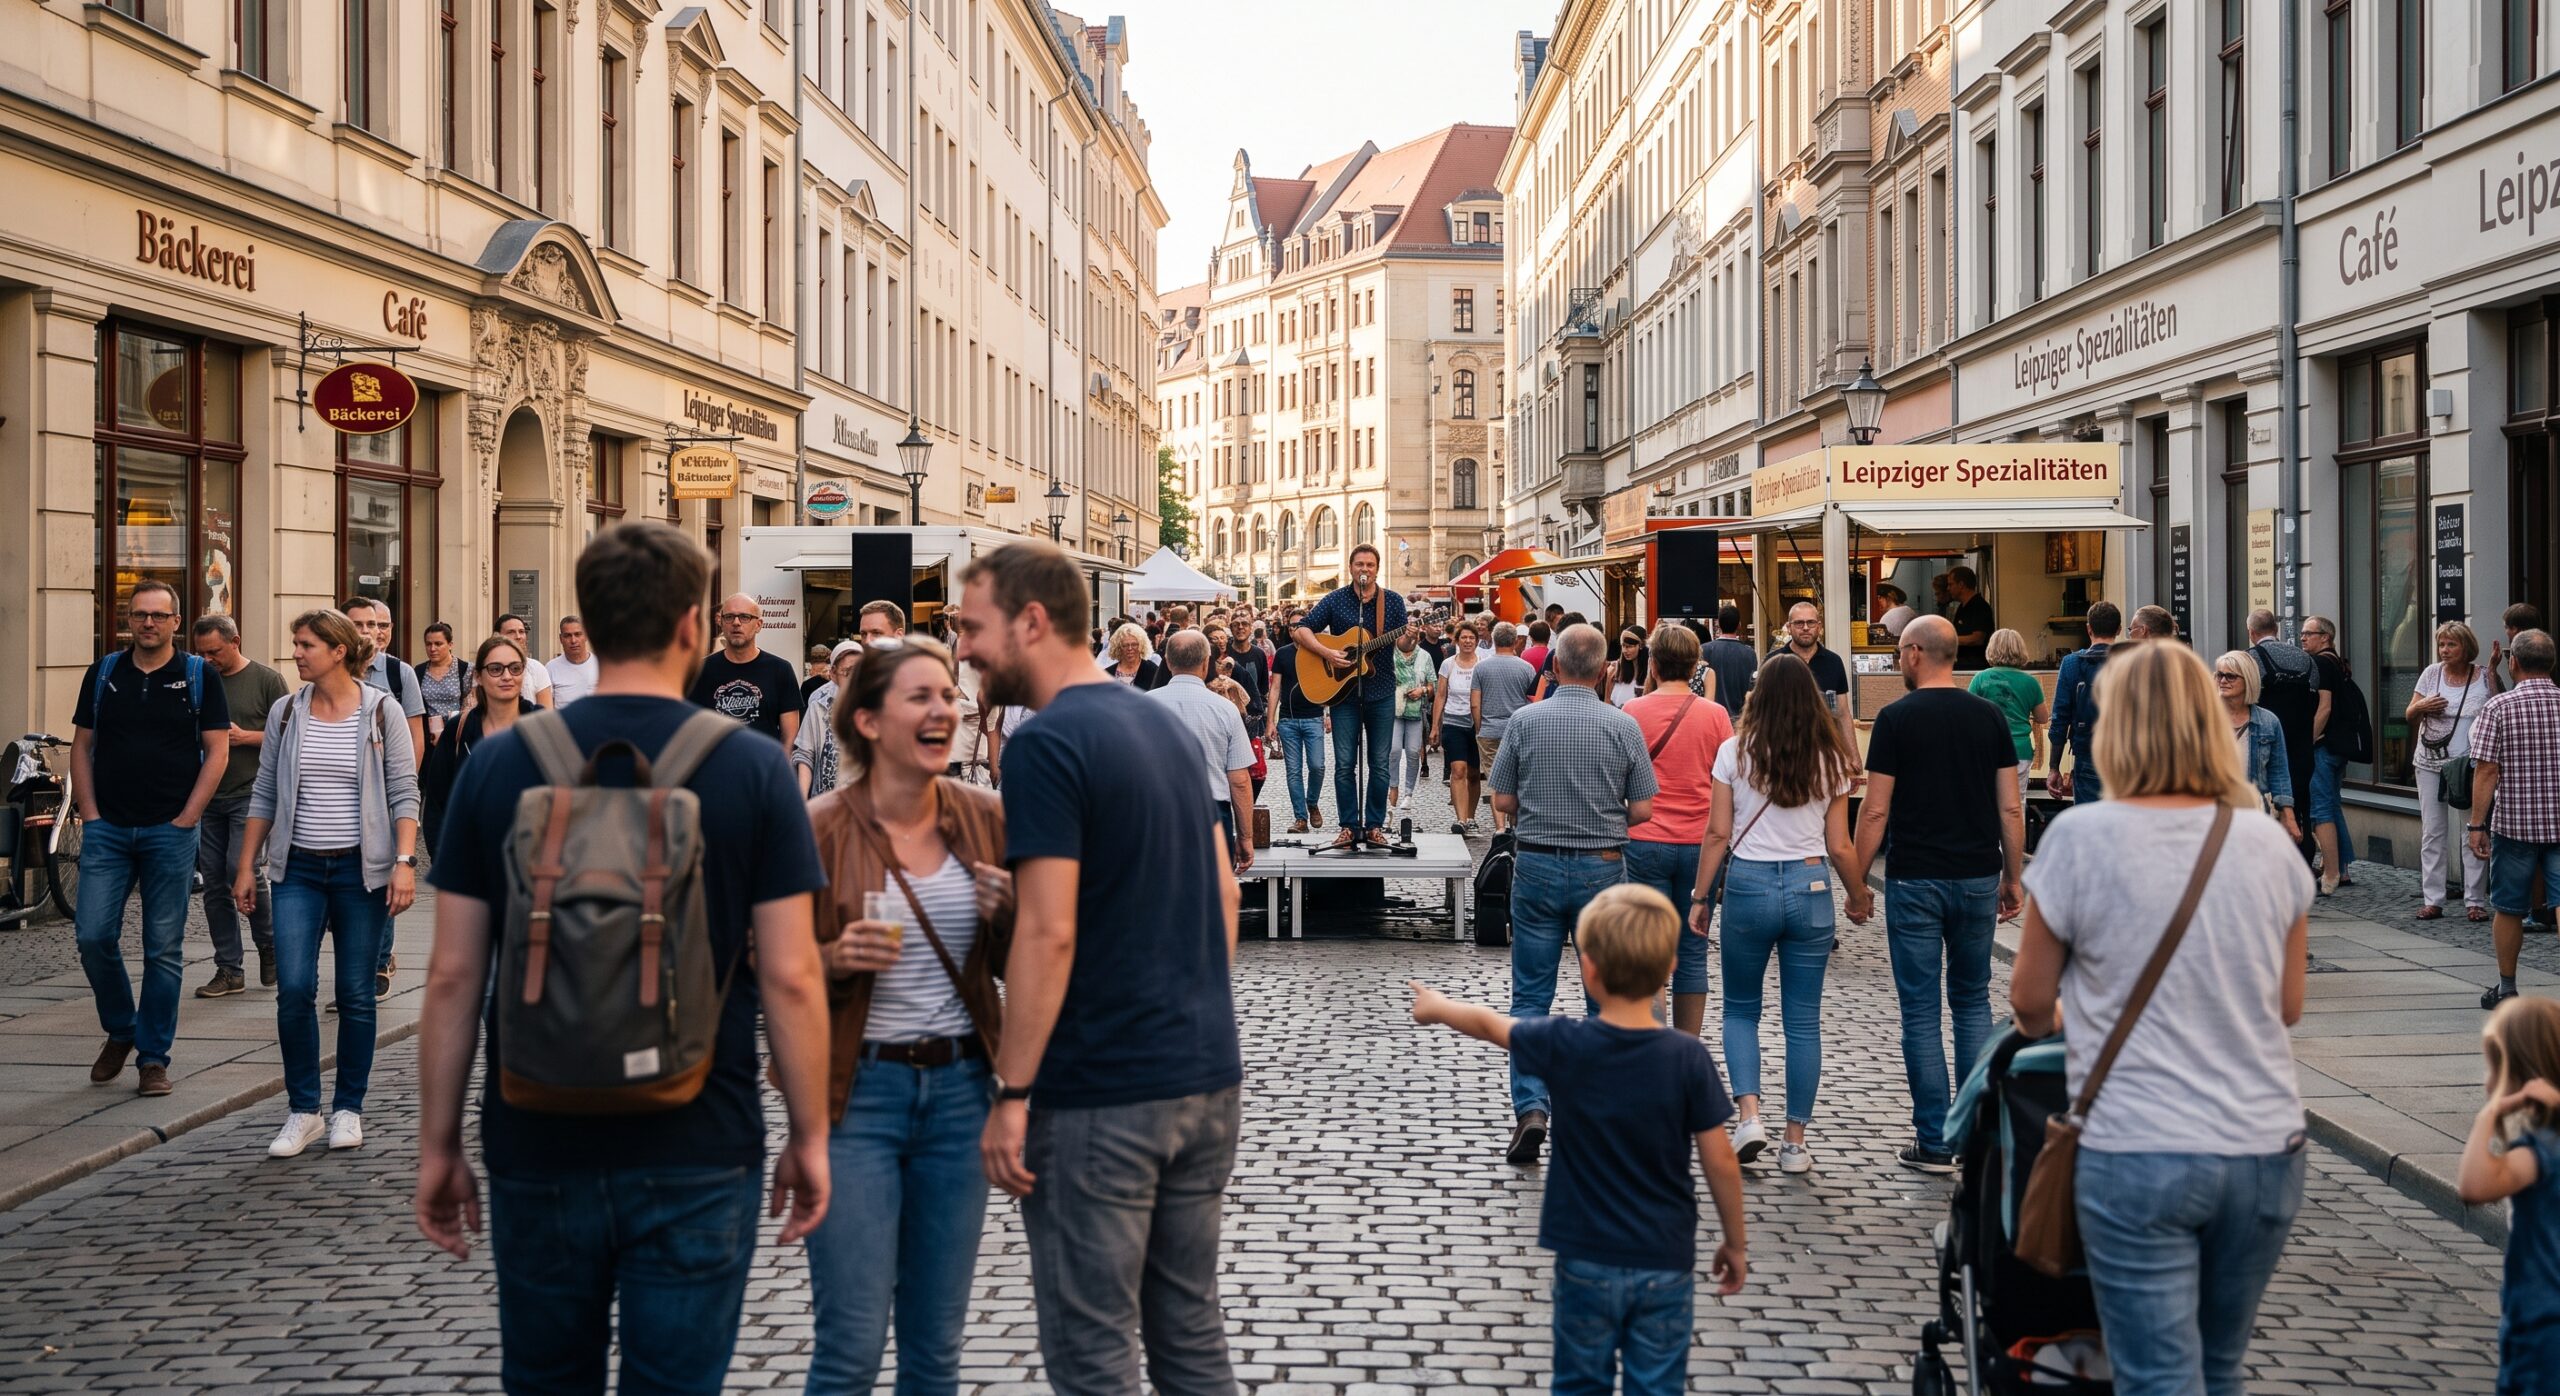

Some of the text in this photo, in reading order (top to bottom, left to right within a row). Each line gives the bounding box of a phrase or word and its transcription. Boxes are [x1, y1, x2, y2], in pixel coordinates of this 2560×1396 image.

[136, 209, 256, 292] Bäckerei
[2339, 205, 2398, 286] Café
[383, 290, 428, 341] Café
[2015, 300, 2177, 396] Leipziger Spezialitäten
[329, 407, 401, 421] Bäckerei
[684, 389, 725, 432] Leipziger
[1842, 458, 2108, 488] Leipziger Spezialitäten
